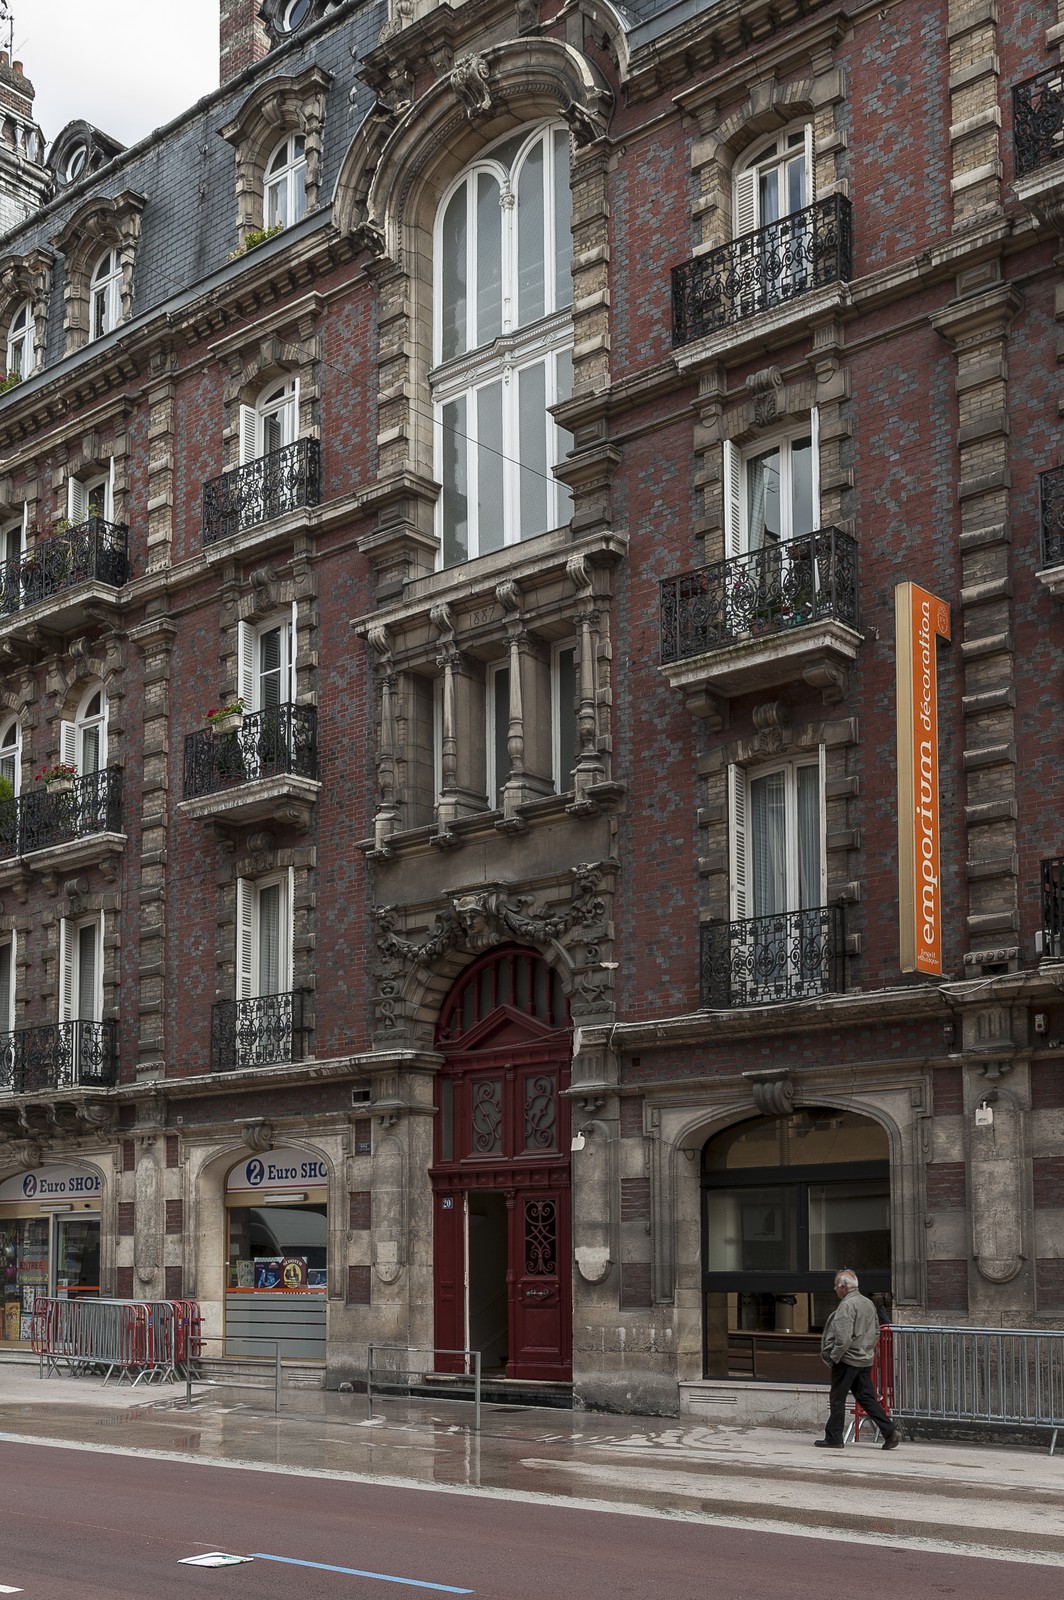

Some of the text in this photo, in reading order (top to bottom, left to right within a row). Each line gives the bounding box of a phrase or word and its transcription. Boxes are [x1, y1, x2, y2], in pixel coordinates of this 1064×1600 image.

[469, 604, 496, 628] 1887
[917, 601, 937, 944] emporium décoration
[249, 1160, 262, 1184] 2
[267, 1164, 298, 1180] Euro
[25, 1175, 35, 1196] 2
[39, 1179, 66, 1193] Euro
